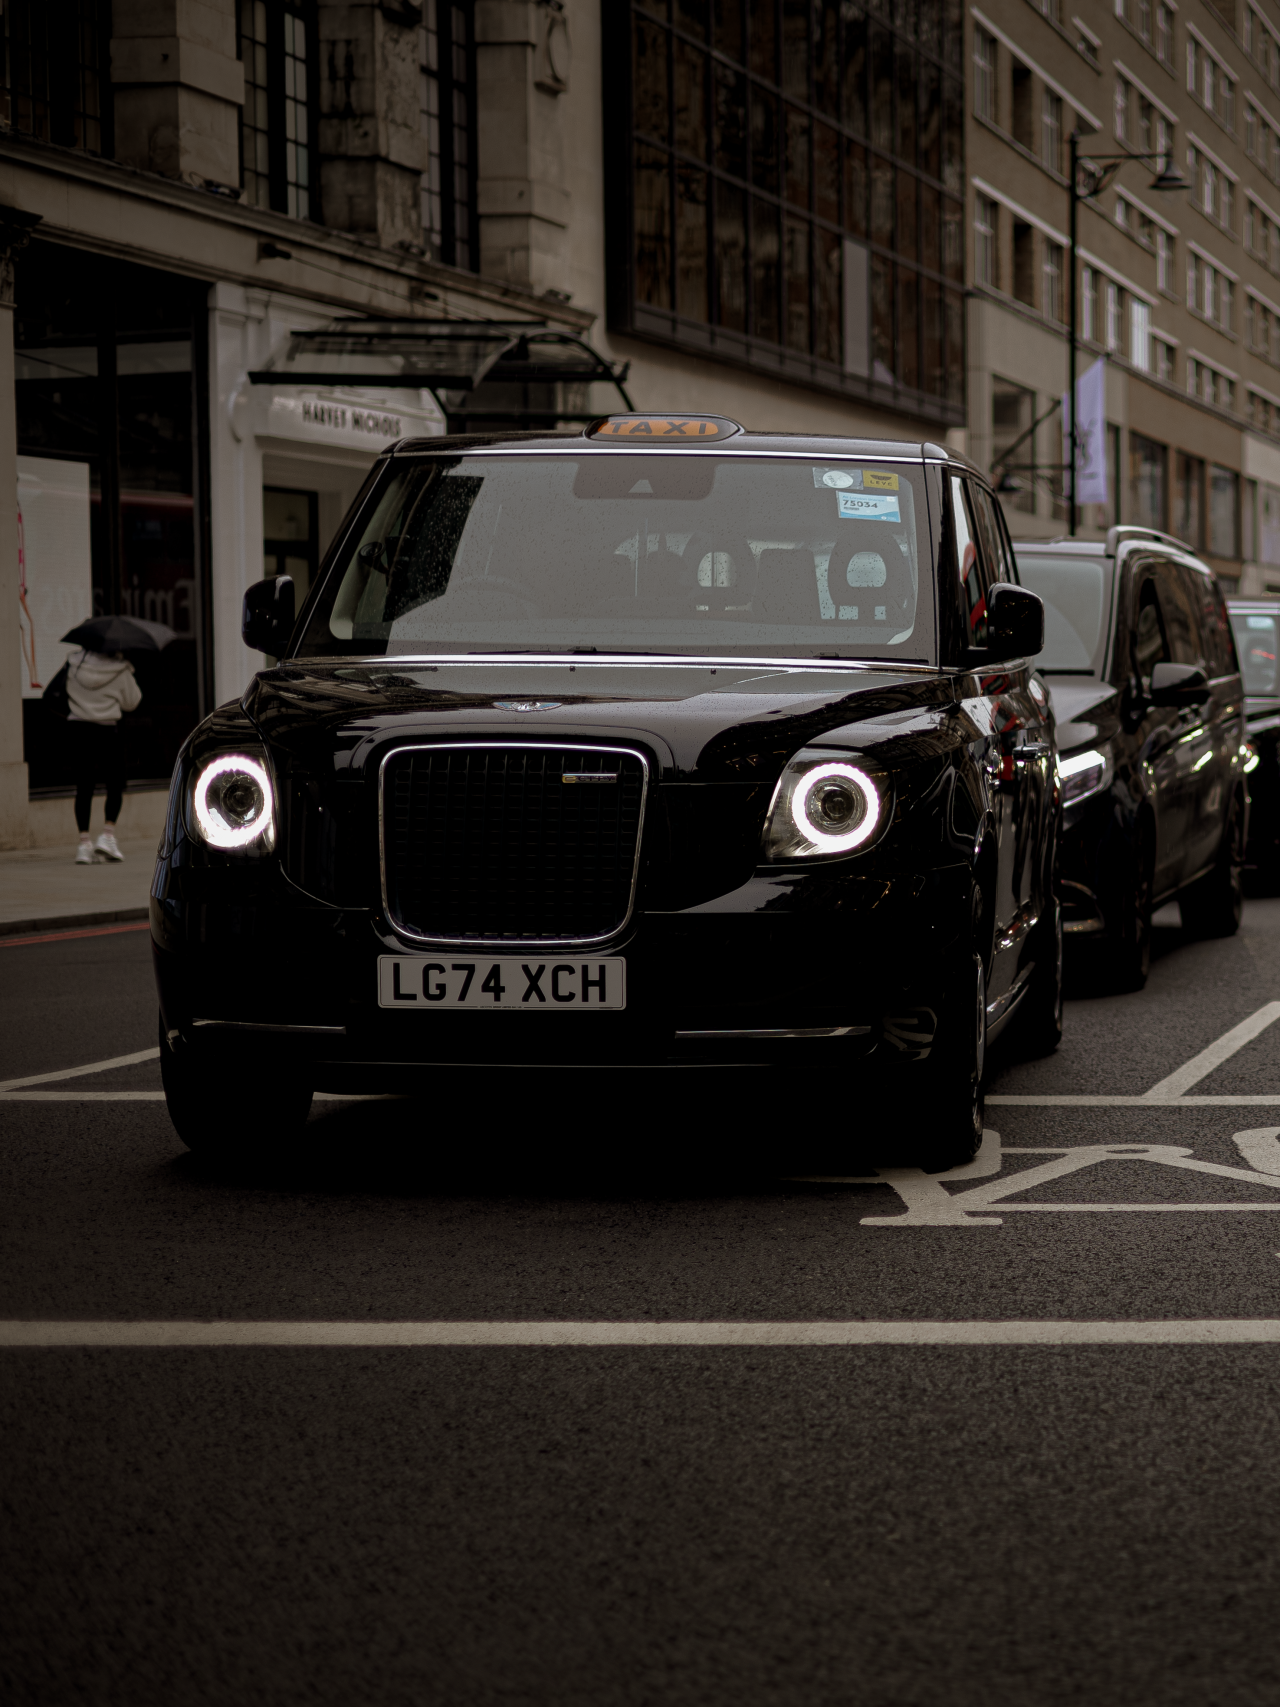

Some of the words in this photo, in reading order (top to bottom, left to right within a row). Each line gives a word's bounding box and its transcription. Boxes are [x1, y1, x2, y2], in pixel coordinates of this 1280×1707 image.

[302, 401, 347, 428] HARVEY
[352, 411, 402, 438] NICHOLS
[609, 420, 707, 433] TAXI
[842, 499, 878, 508] 75034
[392, 962, 505, 1002] LG74
[521, 964, 606, 1002] XCH
